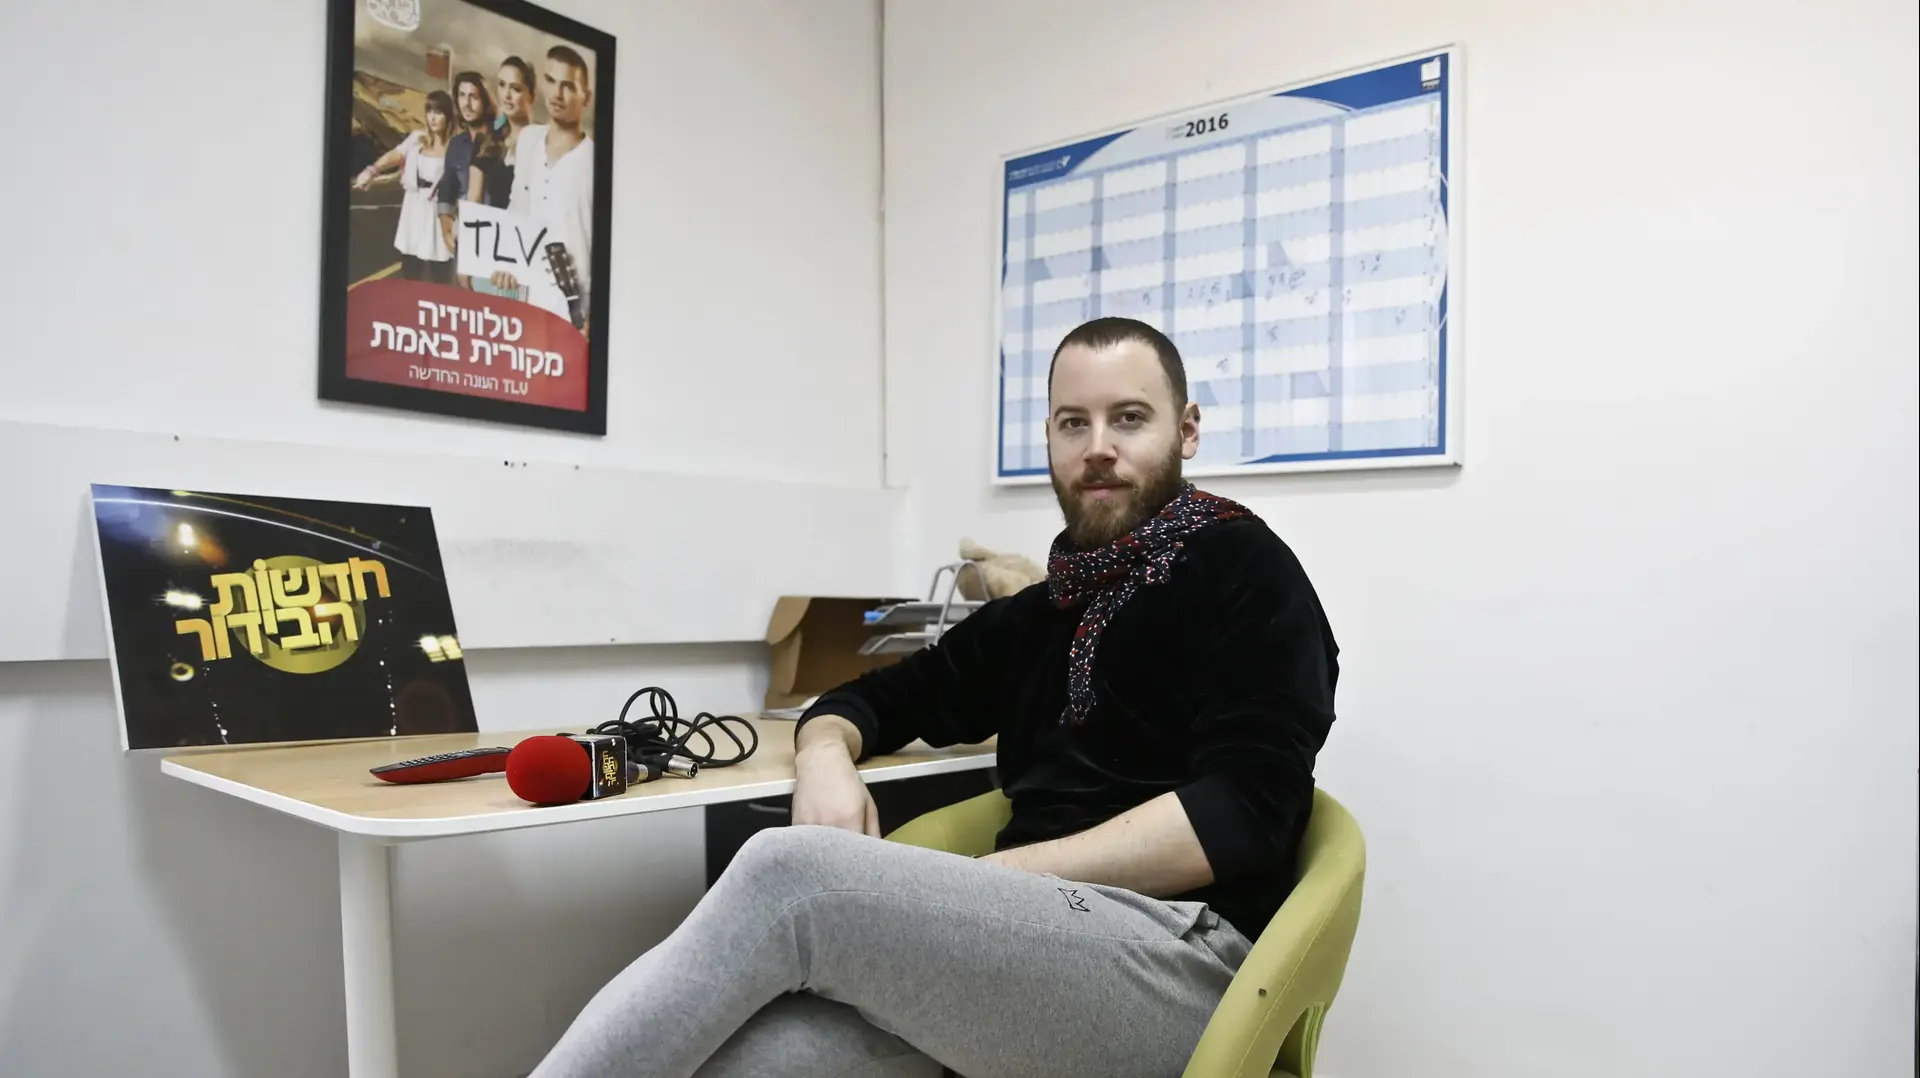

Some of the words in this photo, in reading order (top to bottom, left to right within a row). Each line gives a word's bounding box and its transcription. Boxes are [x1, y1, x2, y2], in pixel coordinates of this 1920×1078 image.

[1185, 113, 1229, 138] 2016
[463, 218, 548, 267] TLV
[417, 299, 523, 342] טלוויזיה
[370, 321, 460, 361] באמת
[469, 338, 564, 379] מקורית
[409, 365, 460, 385] החדשה
[463, 373, 499, 391] העונה
[502, 378, 529, 396] TLV
[175, 601, 359, 662] הבידור
